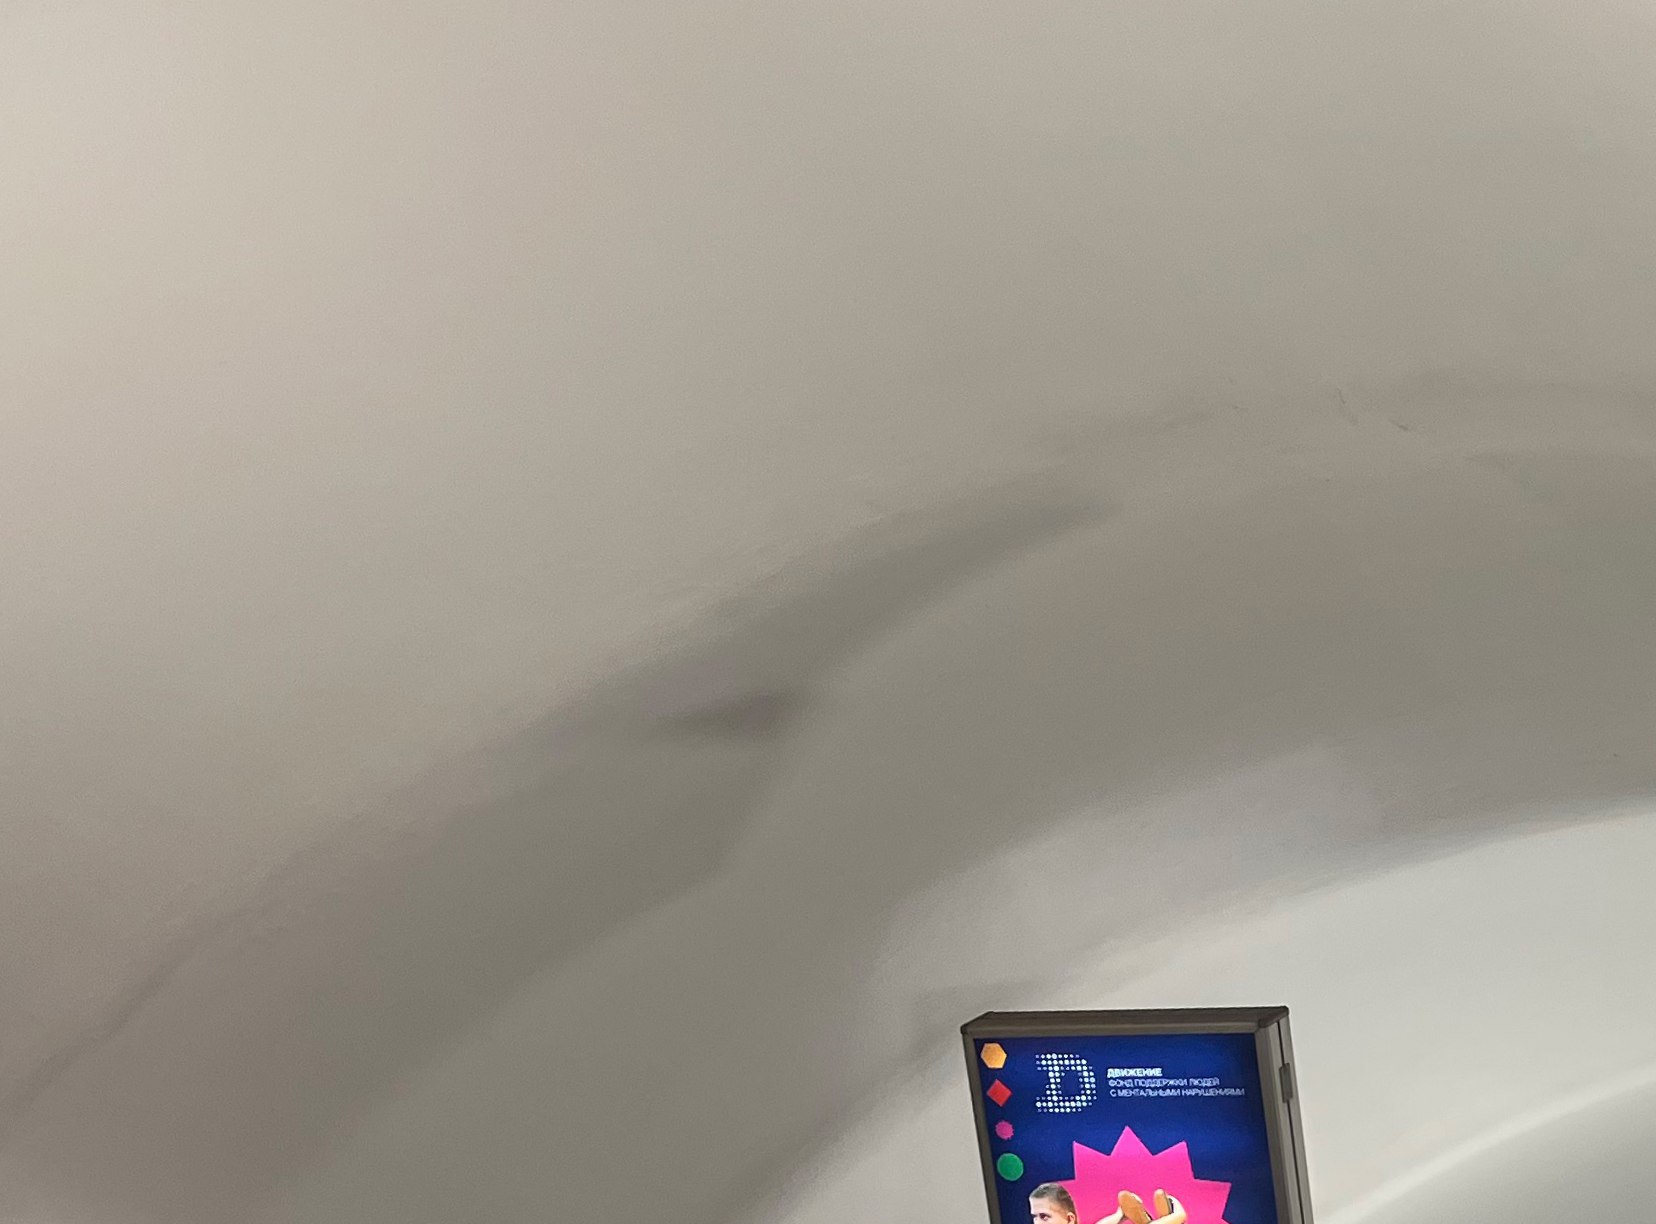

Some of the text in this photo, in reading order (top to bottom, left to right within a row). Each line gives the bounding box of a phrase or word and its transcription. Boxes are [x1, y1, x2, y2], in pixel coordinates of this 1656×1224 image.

[1107, 1068, 1163, 1078] ДВИЖЕНИЕ
[1109, 1077, 1220, 1088] ФОНД ПОДДЕРЖКИ ЛЮДЕЙ
[1181, 1088, 1245, 1097] НАРУШЕНИЯМИ
